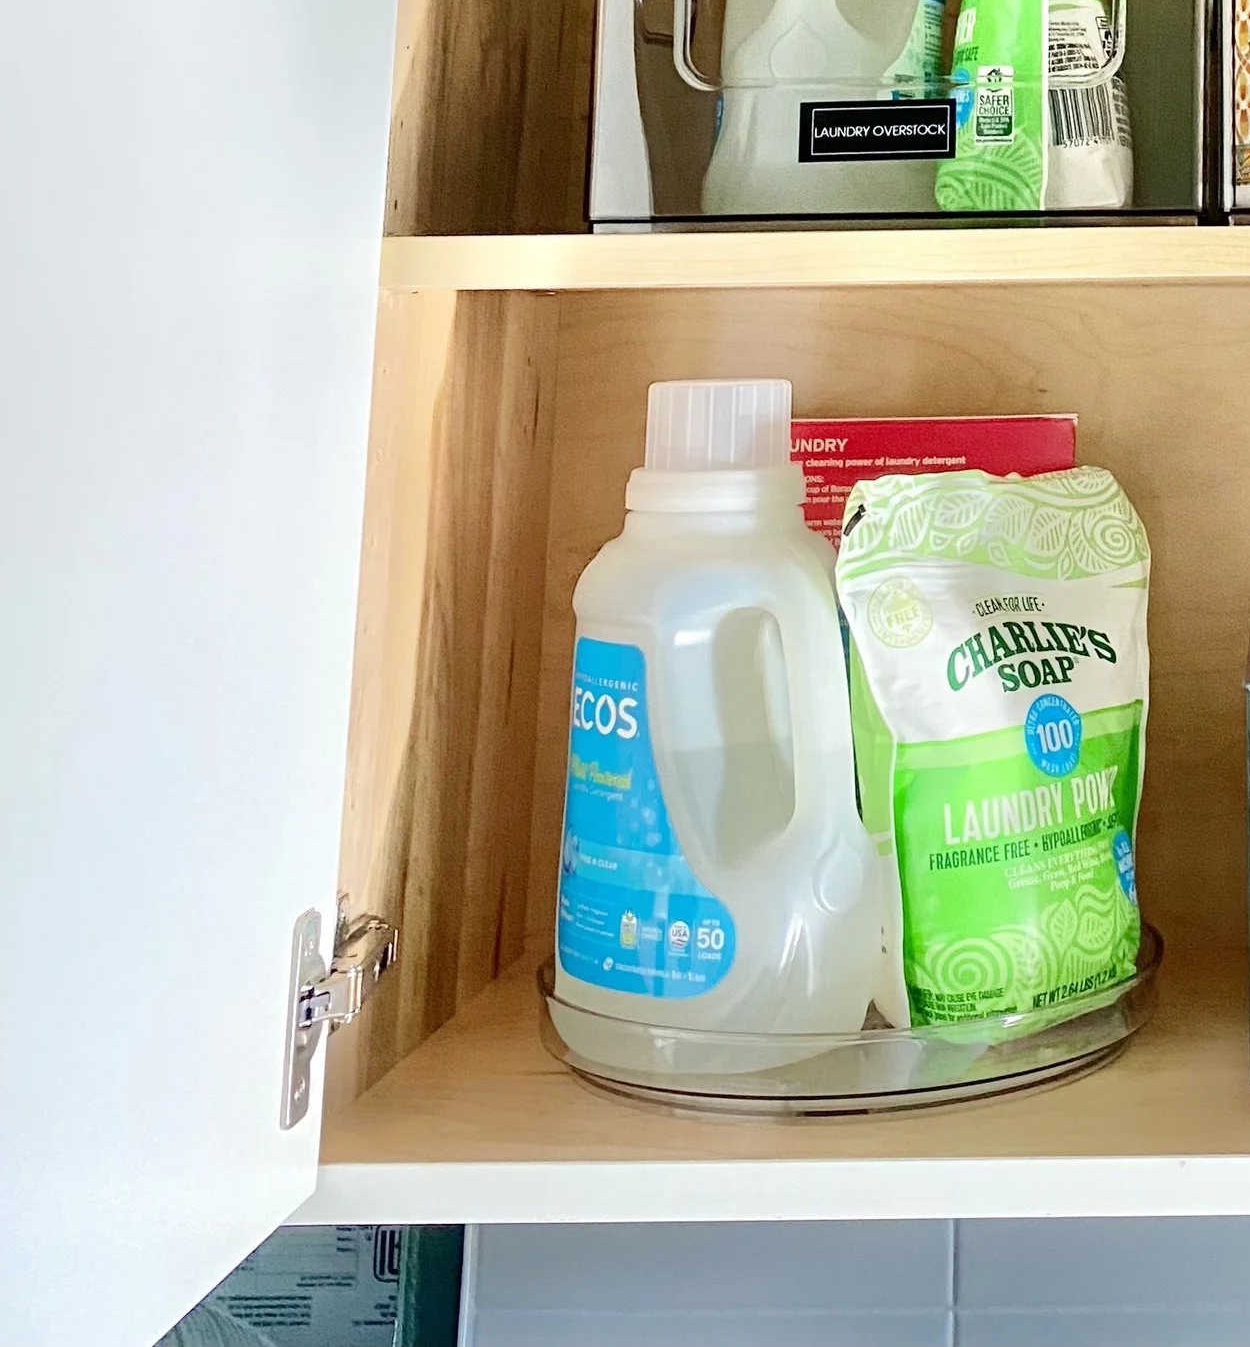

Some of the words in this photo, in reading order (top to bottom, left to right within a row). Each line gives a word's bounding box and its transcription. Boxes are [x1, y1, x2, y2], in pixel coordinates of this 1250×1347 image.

[979, 106, 1009, 116] CHOICE
[980, 94, 1010, 106] SAFER
[814, 125, 871, 139] LAUNDRY
[873, 123, 946, 137] OVERSTOCK
[805, 457, 844, 468] cleaning
[845, 458, 873, 468] power
[874, 457, 885, 467] of
[885, 456, 921, 467] laundry
[922, 455, 967, 466] detergent
[831, 495, 845, 503] the
[823, 519, 842, 527] wate
[975, 597, 1003, 618] CLEAN
[1002, 596, 1020, 613] FOR
[1021, 596, 1043, 613] LIFE
[946, 621, 1118, 692] CHARLIE'S
[997, 656, 1075, 693] SOAP
[573, 687, 639, 740] ECOS
[1035, 718, 1074, 755] 100
[943, 781, 1064, 846] LAUNDRY
[929, 844, 1000, 871] FRAGRANCE
[1004, 839, 1031, 861] FREE
[671, 929, 688, 939] USA
[696, 928, 725, 951] 50
[697, 952, 722, 961] LOADS
[1032, 991, 1048, 1010] NET
[1049, 987, 1061, 1004] WT
[1061, 981, 1079, 999] 2.64
